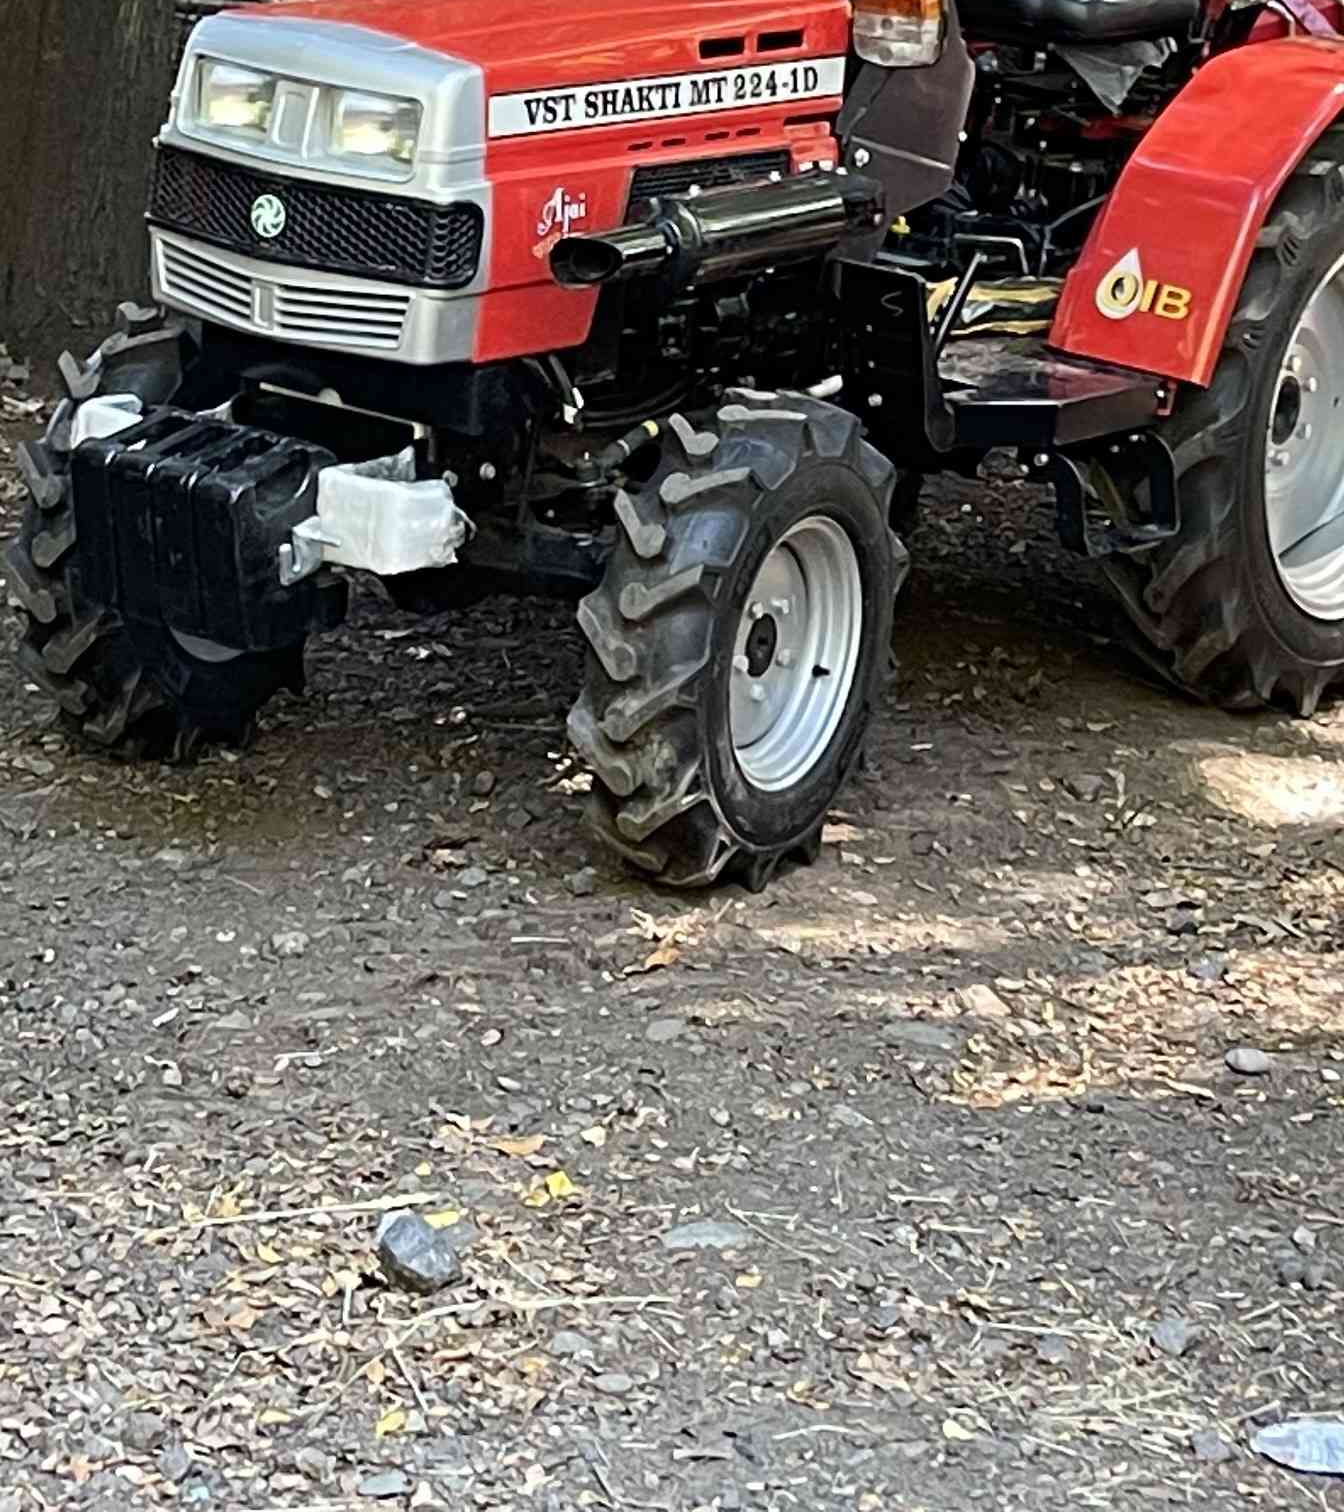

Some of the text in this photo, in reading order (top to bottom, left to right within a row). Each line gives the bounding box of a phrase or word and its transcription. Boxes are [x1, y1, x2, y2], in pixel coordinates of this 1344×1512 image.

[524, 67, 819, 125] VST SHAKTI MT 224-1D
